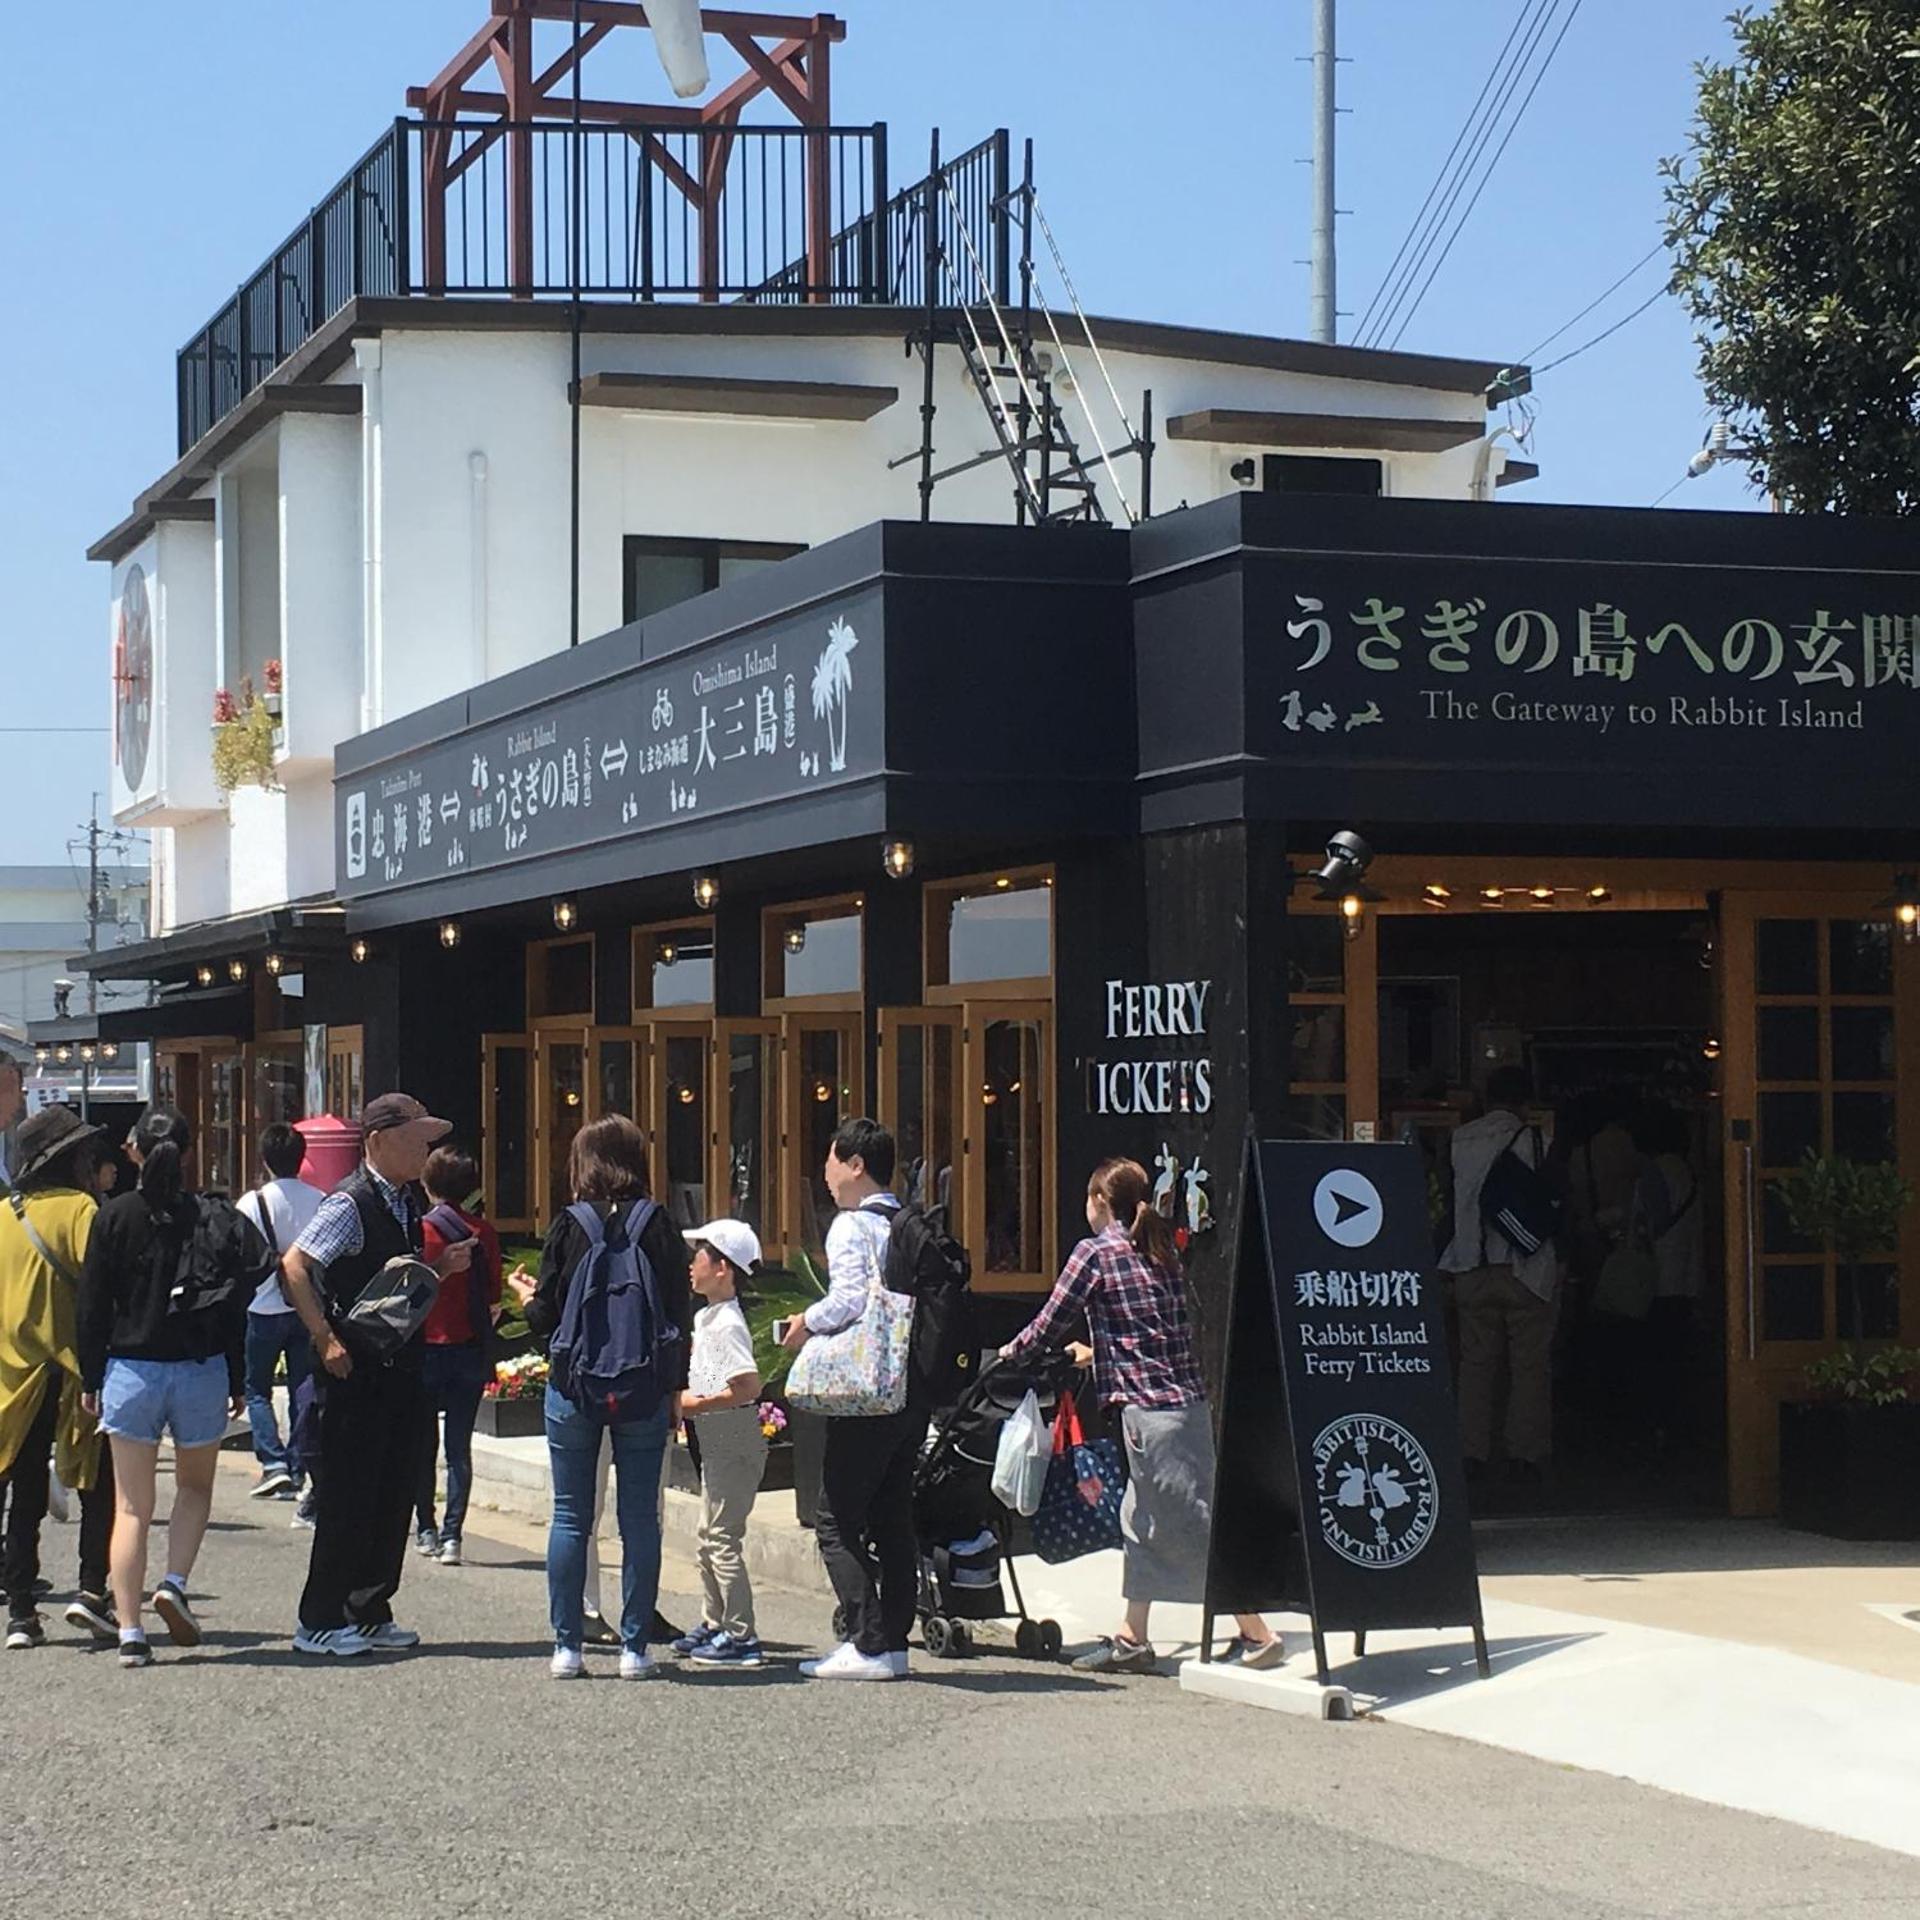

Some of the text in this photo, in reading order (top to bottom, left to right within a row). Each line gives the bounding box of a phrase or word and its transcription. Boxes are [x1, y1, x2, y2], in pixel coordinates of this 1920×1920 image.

[1286, 594, 1920, 688] うさぎの島への玄関
[692, 643, 778, 697] Omishima Island
[693, 685, 779, 776] 大三島
[1420, 690, 1864, 734] The Gateway to Rabbit Island
[495, 747, 580, 827] うさぎの島
[1293, 1270, 1423, 1308] 乗船切符
[1300, 1321, 1429, 1346] Rabbit Island
[1305, 1351, 1431, 1383] Ferry Tickets
[1361, 1421, 1426, 1474] ISLAND
[1390, 1490, 1432, 1560] RABBIT
